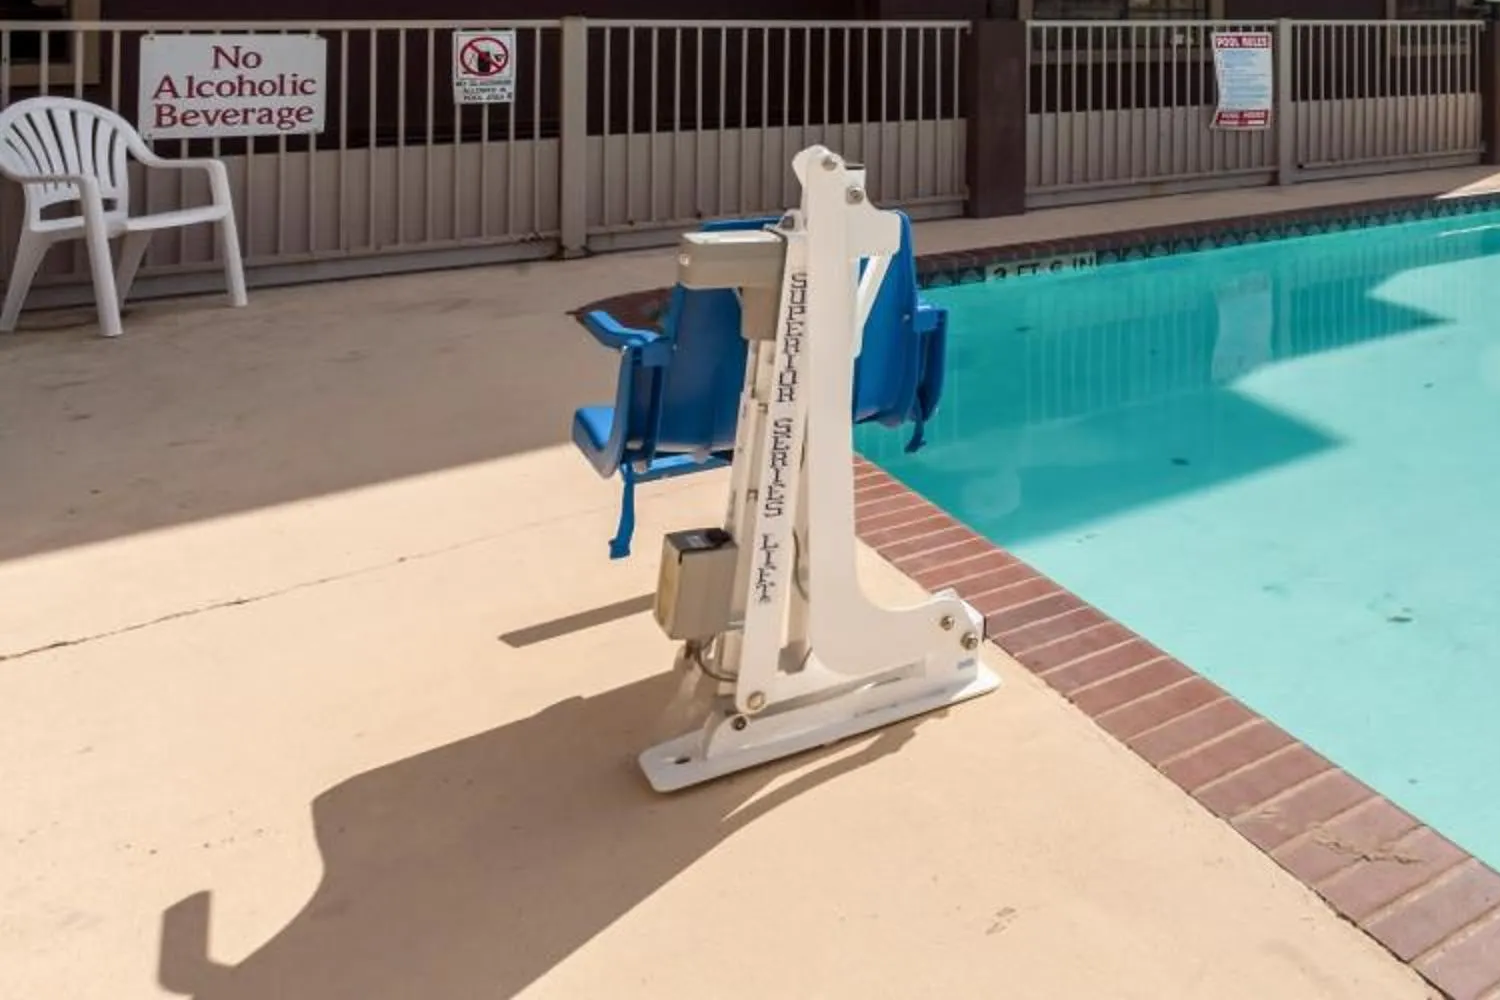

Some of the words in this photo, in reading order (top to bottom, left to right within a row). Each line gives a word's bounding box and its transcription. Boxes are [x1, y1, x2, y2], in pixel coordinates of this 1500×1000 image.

[1217, 37, 1240, 47] POOL
[212, 45, 262, 70] No
[153, 73, 317, 99] Alcoholic
[154, 103, 314, 131] Beverage
[777, 272, 808, 402] SUPERIOR
[763, 417, 794, 518] SERIES
[756, 533, 779, 604] LIFT
